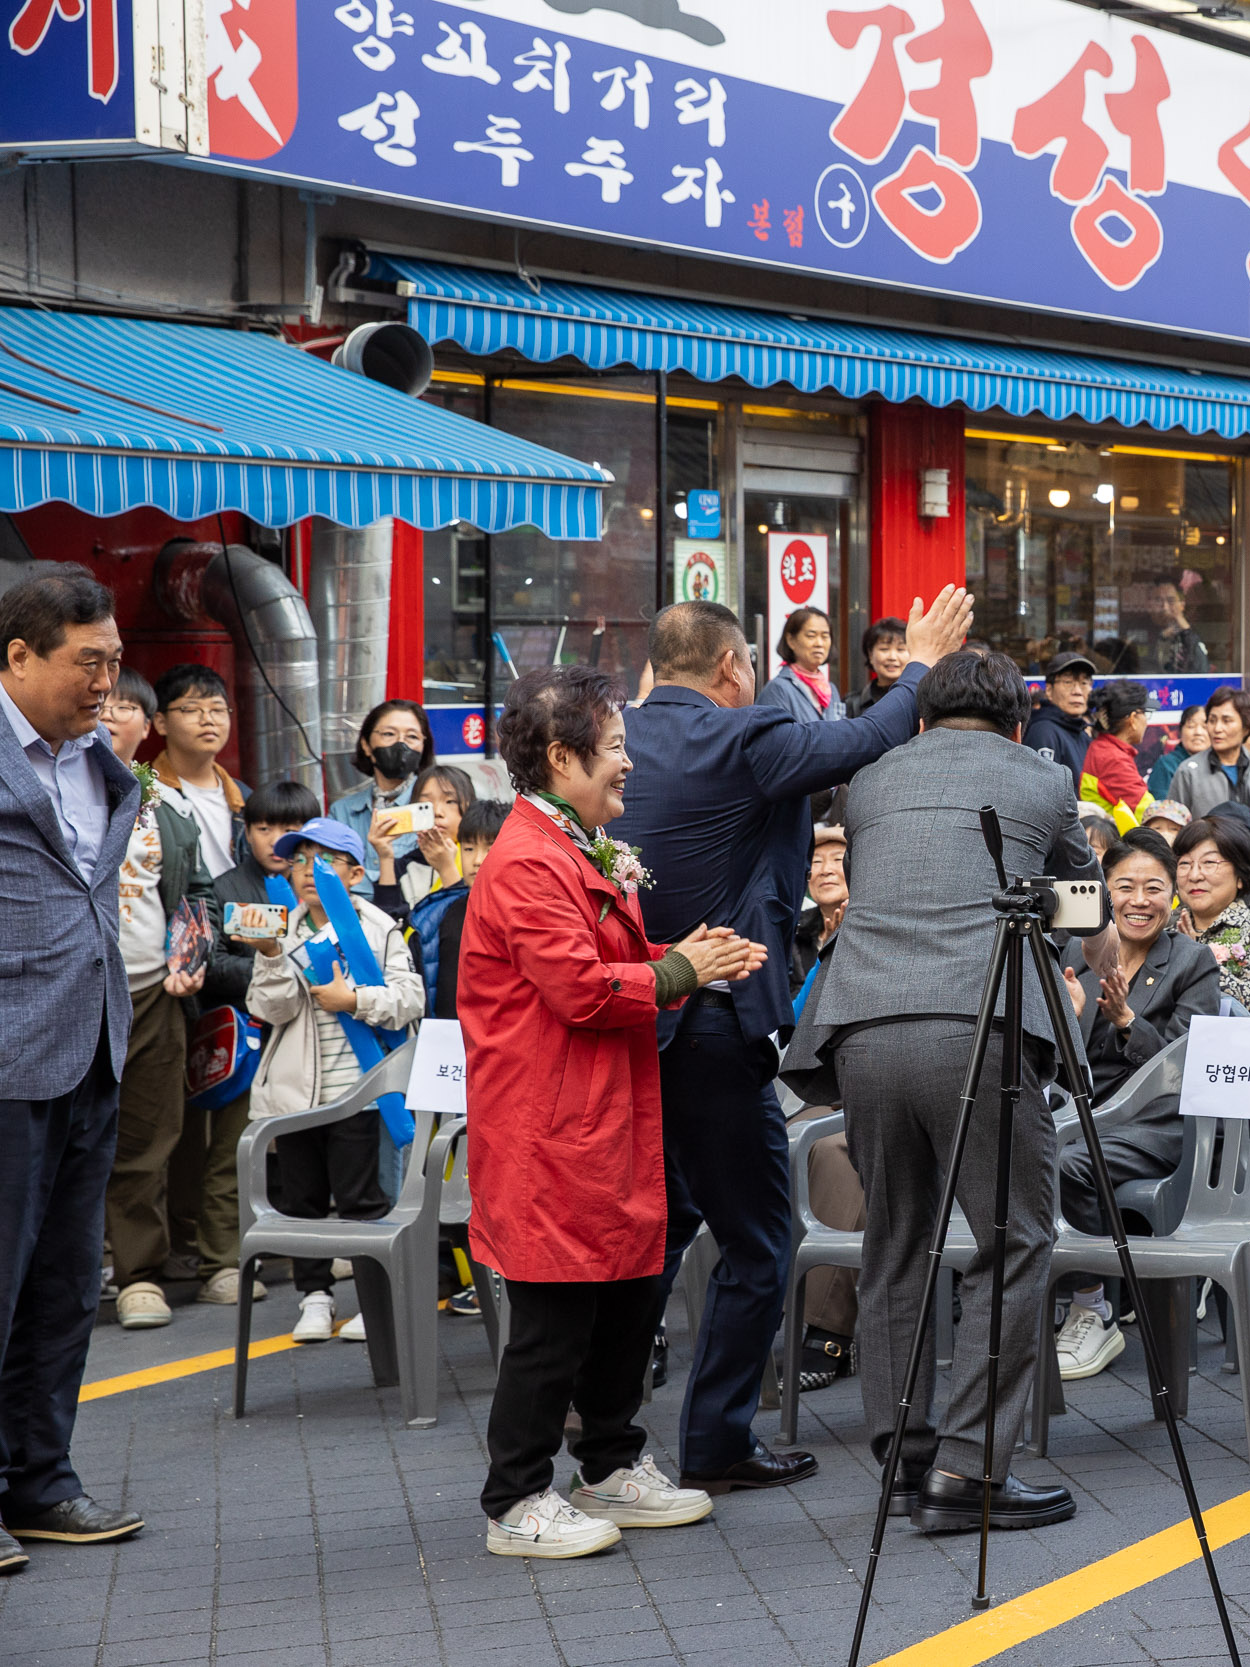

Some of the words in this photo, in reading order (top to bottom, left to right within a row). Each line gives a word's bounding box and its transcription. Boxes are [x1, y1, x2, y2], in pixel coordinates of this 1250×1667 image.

[338, 91, 735, 228] 선두주자
[746, 198, 804, 249] 본점
[782, 553, 814, 586] 원조
